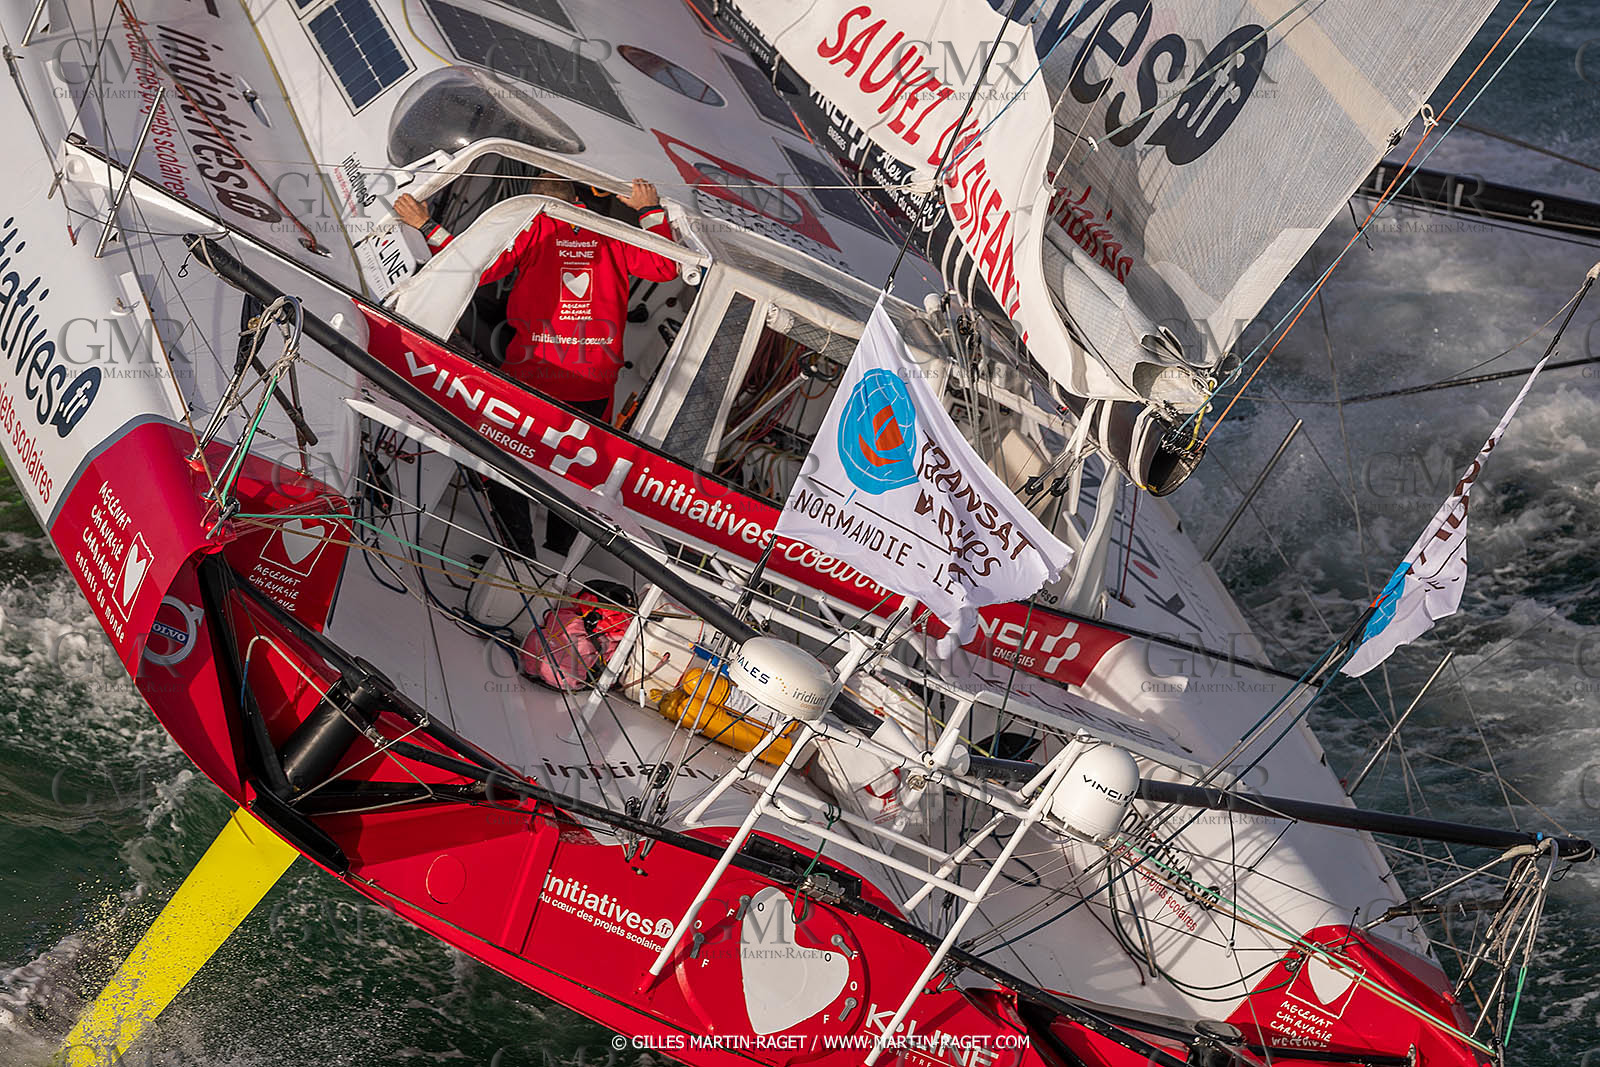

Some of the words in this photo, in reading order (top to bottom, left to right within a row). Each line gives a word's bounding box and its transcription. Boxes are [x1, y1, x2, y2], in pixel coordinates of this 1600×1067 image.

[817, 5, 955, 145] SAUVEZ
[1528, 200, 1545, 222] 3
[404, 351, 535, 438] VINCI
[478, 423, 537, 460] ENERGIES
[12, 420, 53, 504] scolaires
[793, 489, 913, 568] NORMANDIE
[253, 564, 302, 587] MECENAT
[75, 551, 98, 593] enfants
[96, 588, 106, 609] du
[104, 605, 125, 644] monde
[151, 623, 187, 642] OLVO
[978, 614, 1039, 651] NCI
[992, 647, 1037, 668] ENERGIES
[1083, 774, 1123, 801] VINCI
[538, 892, 552, 904] Au
[577, 909, 594, 923] des
[593, 917, 625, 937] projets
[1166, 895, 1198, 932] scolaires
[1280, 1000, 1334, 1028] MECENAT
